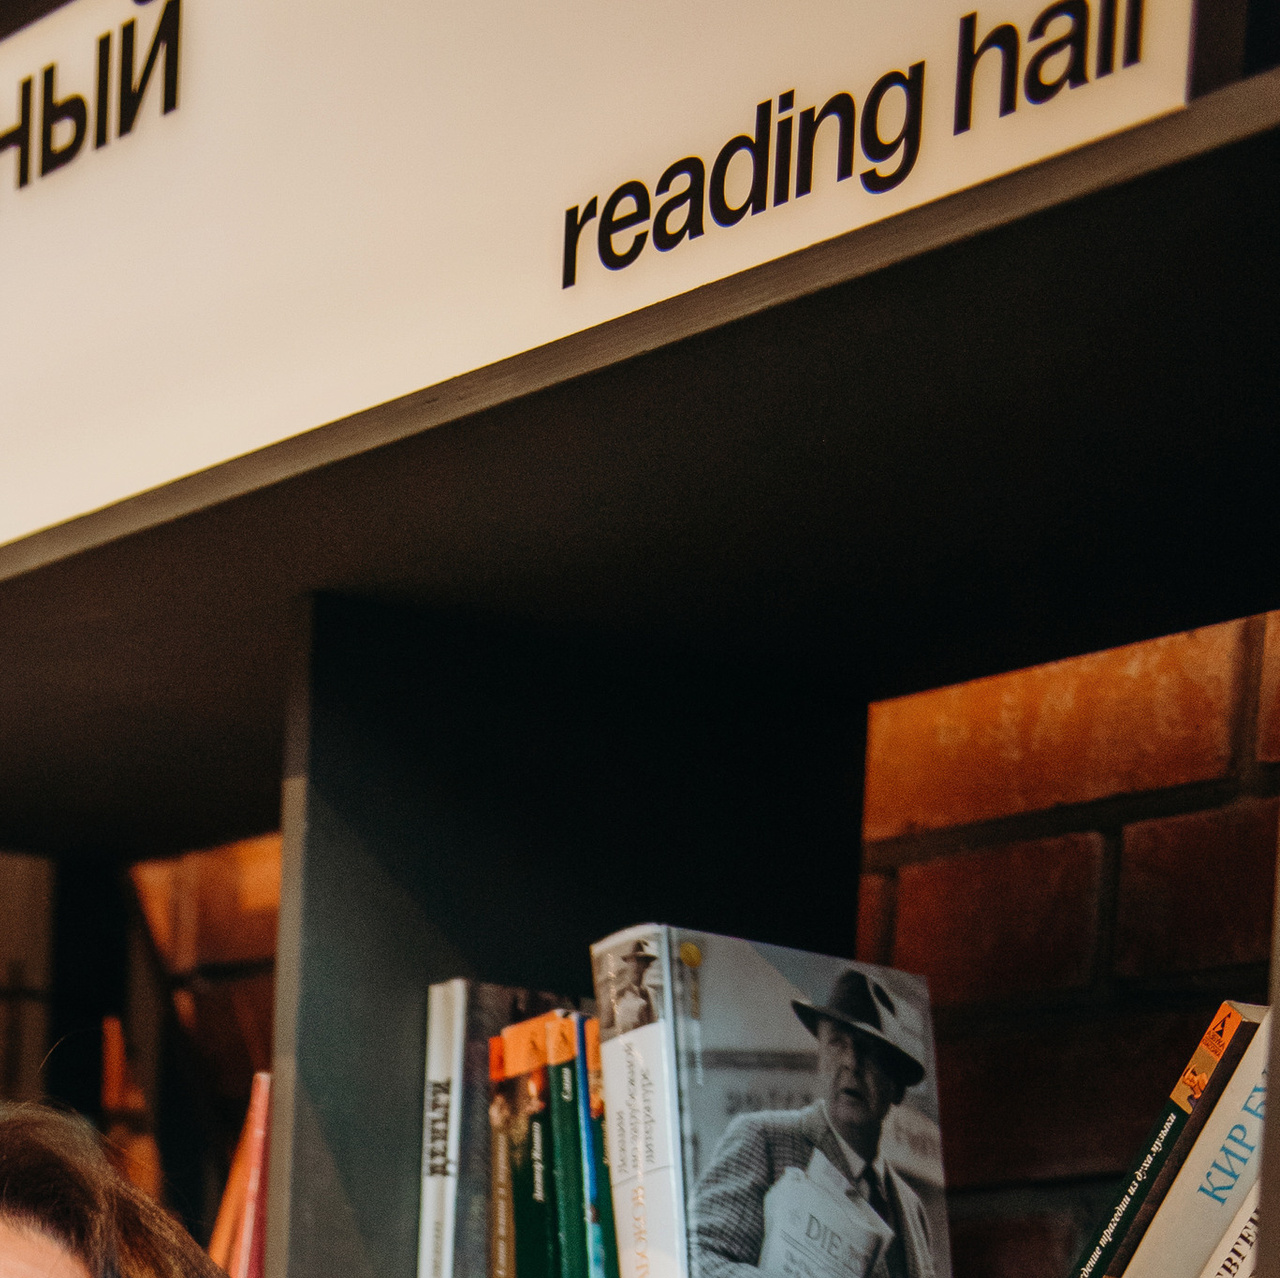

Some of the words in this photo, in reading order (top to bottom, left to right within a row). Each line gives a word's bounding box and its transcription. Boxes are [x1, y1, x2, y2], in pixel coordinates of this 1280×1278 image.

[562, 58, 926, 290] reading
[953, 0, 1145, 136] hall
[428, 1077, 457, 1177] ДЕНЬГИ
[1197, 1124, 1256, 1206] КИР
[1099, 1195, 1131, 1247] трагедии
[1128, 1181, 1138, 1196] из
[1135, 1154, 1154, 1182] духа
[1150, 1113, 1177, 1156] музыки
[805, 1214, 842, 1260] DIE
